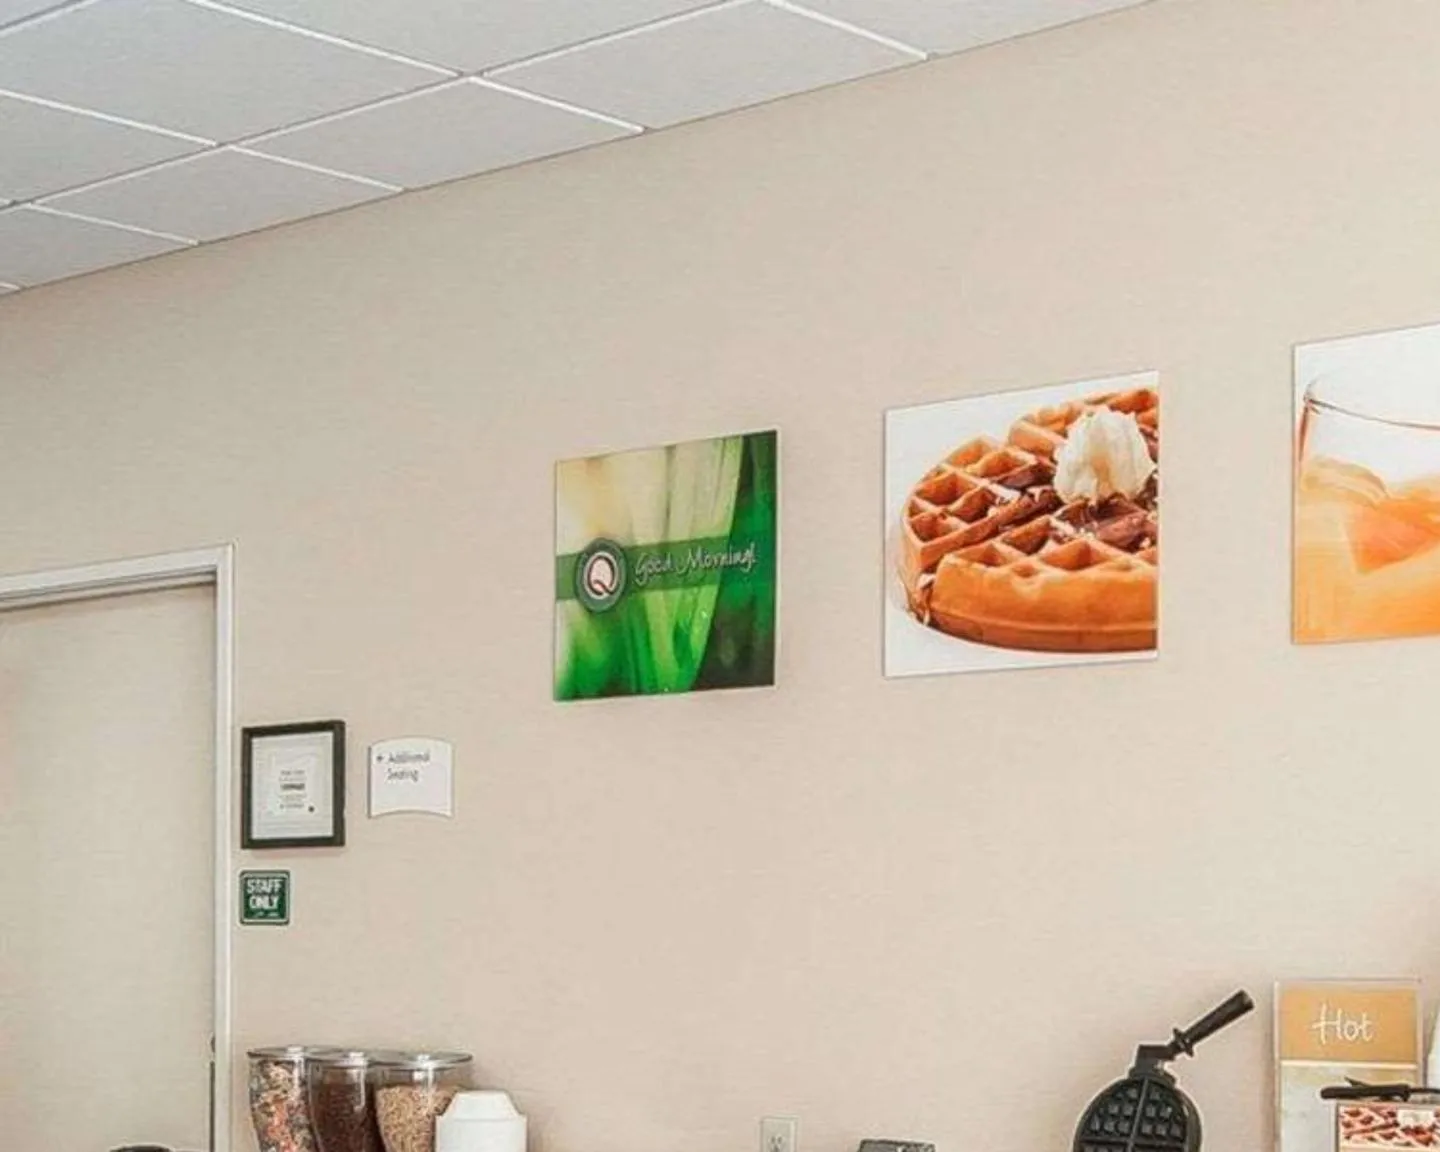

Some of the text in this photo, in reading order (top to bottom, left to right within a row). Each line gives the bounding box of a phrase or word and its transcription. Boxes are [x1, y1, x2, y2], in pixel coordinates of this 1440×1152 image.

[587, 554, 620, 596] Q
[635, 542, 756, 587] Good Morning!
[386, 767, 419, 783] Seating
[247, 878, 283, 894] STAFF
[249, 895, 280, 910] ONLY
[1311, 1002, 1374, 1046] Hot
